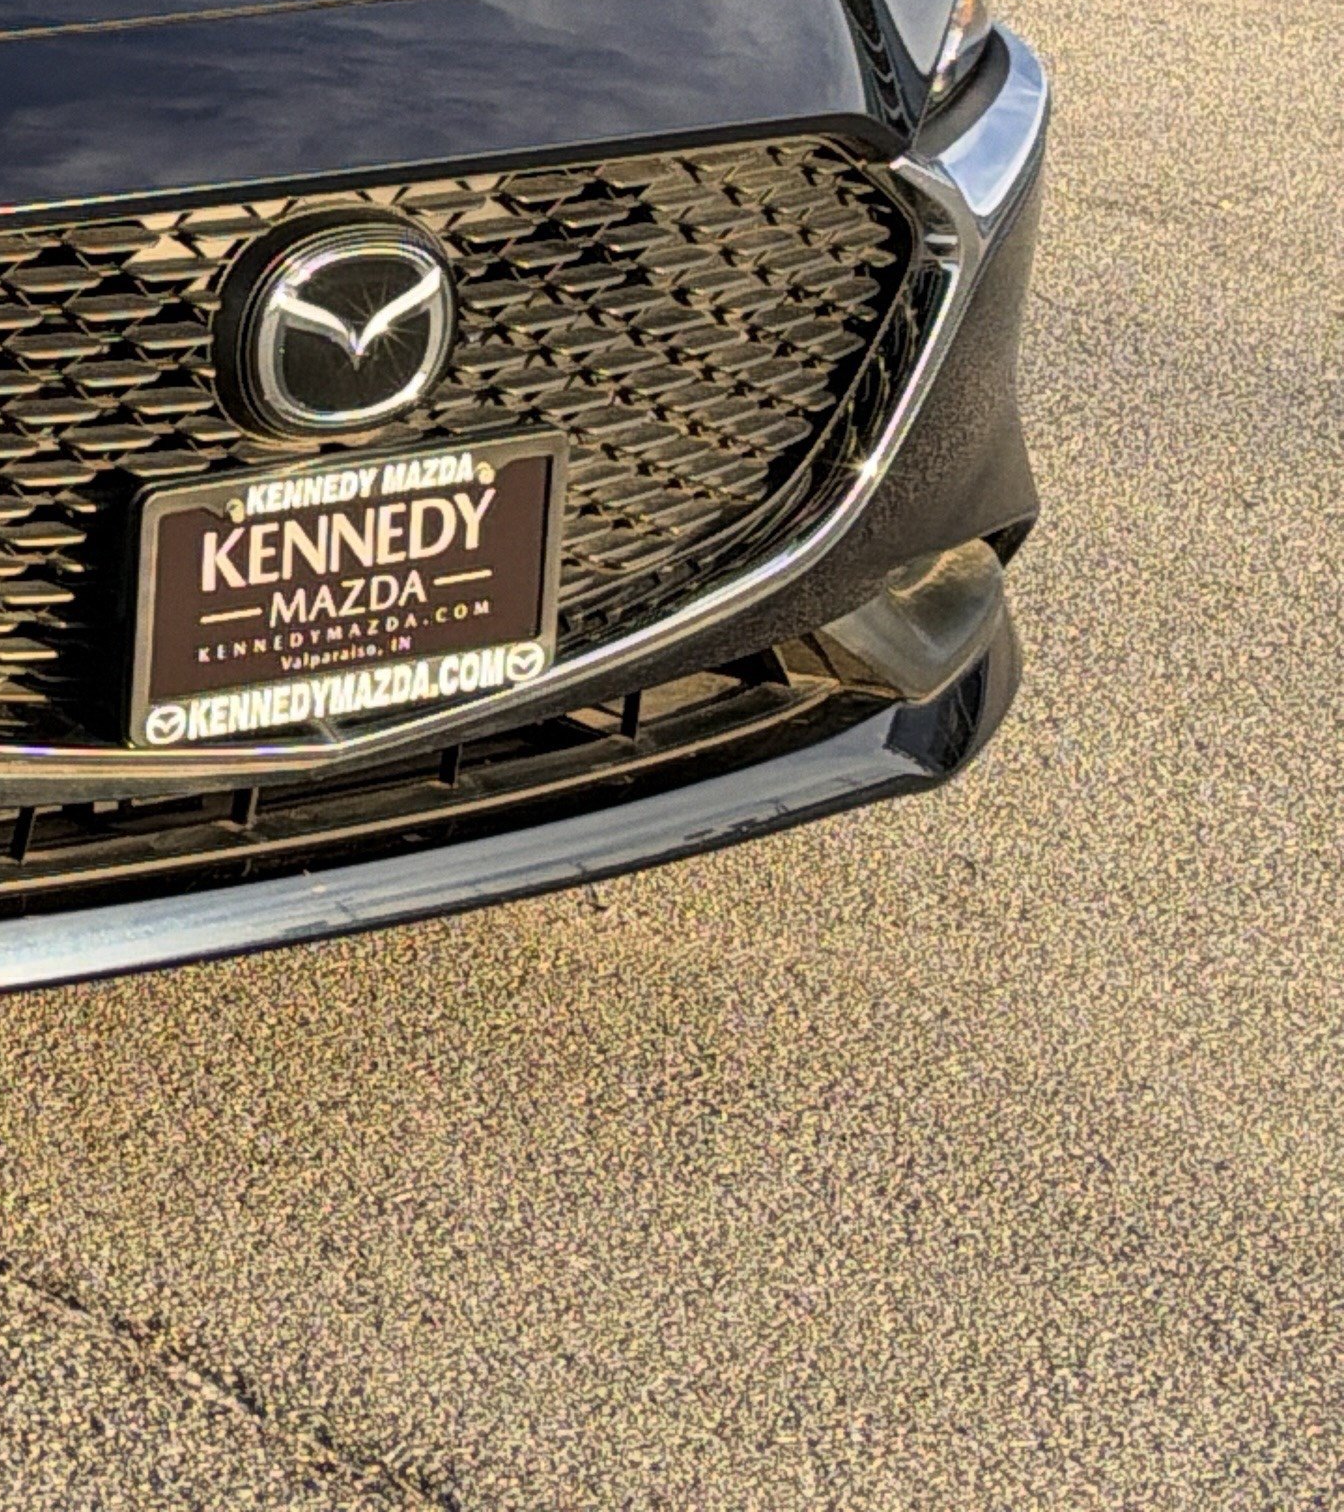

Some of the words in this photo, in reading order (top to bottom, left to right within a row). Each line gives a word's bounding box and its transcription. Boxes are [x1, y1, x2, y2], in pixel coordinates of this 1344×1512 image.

[246, 467, 378, 516] KENNEDY
[381, 452, 475, 494] MAZDA
[201, 488, 497, 592] KENNEDY
[269, 569, 428, 628] MAZDA
[390, 635, 412, 652] IN
[187, 645, 506, 740] KENNEDYMAZDA.COM
